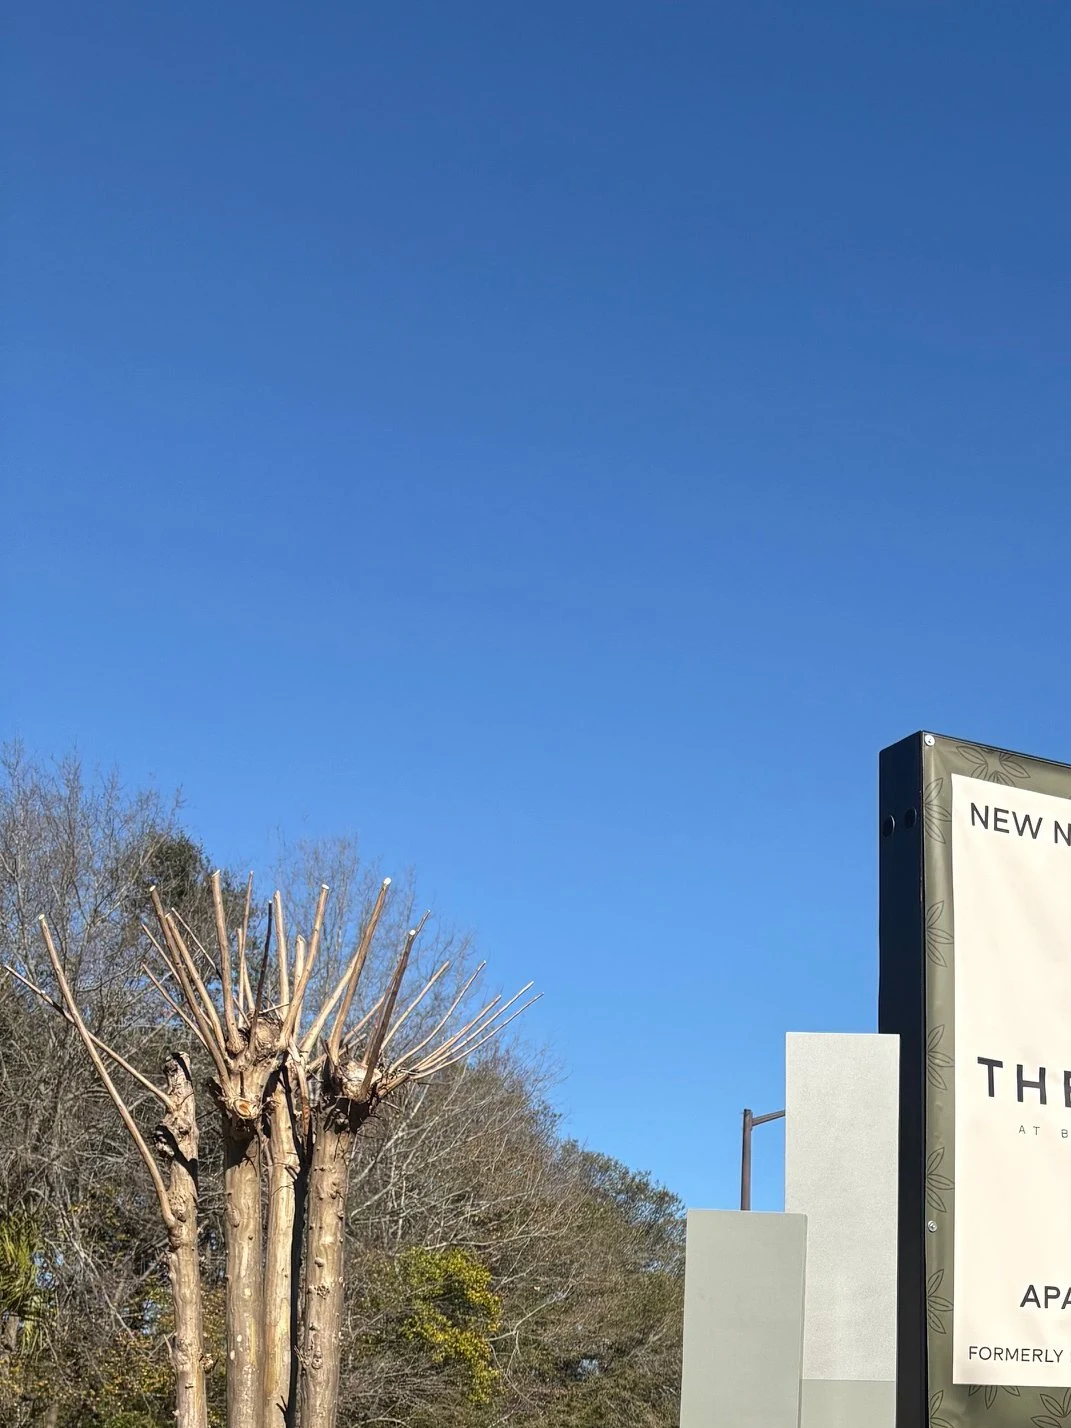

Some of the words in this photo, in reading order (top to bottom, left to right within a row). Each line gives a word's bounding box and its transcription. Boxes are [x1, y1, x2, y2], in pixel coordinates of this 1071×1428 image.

[970, 802, 1044, 840] NEW
[1018, 1124, 1042, 1137] AT
[968, 1345, 1064, 1364] FORMERLY
